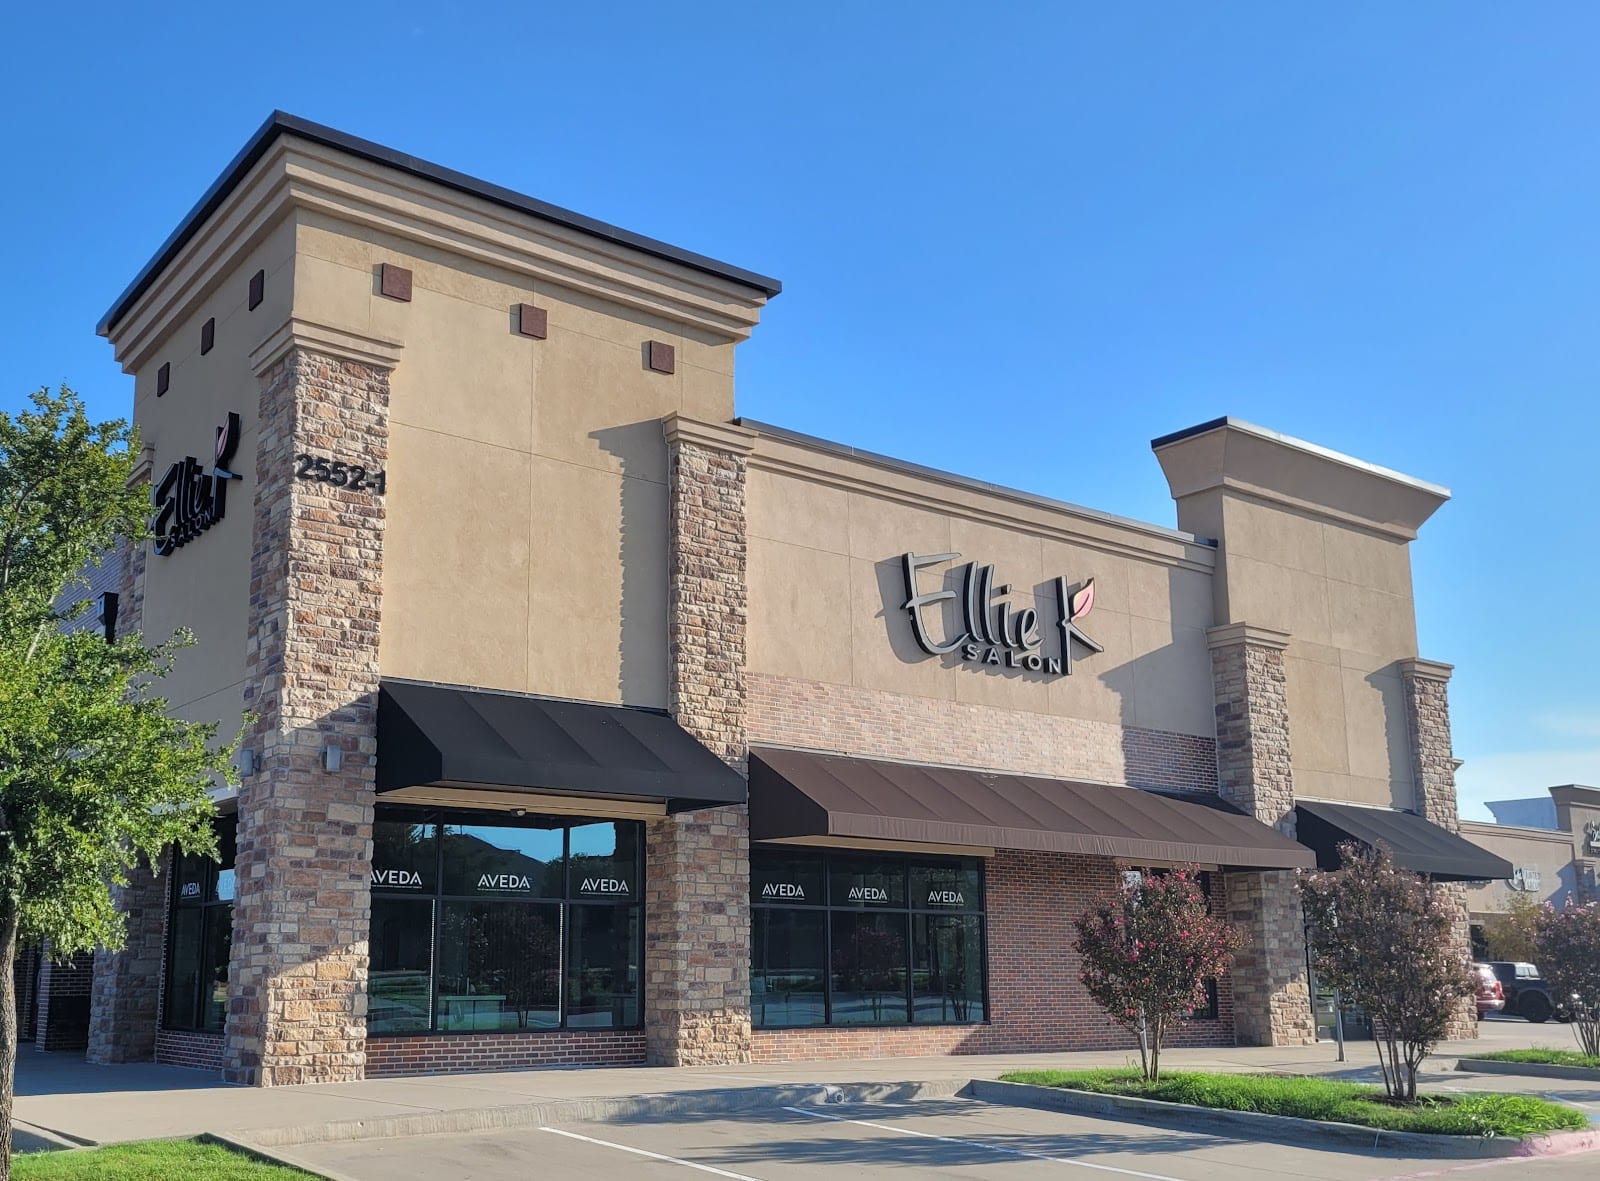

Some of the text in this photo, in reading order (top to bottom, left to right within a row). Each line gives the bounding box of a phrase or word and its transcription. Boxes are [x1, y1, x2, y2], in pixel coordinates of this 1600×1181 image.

[296, 454, 386, 494] 2552-1
[170, 508, 216, 547] SALON
[900, 552, 1045, 655] Ellie
[961, 643, 1063, 674] SALON
[477, 873, 530, 888] AVEDA
[580, 878, 629, 892] AVEDA
[181, 882, 200, 897] AVEDA
[762, 883, 804, 897] AVEDA
[848, 887, 887, 900] AVEDA
[928, 891, 964, 903] AVEDA
